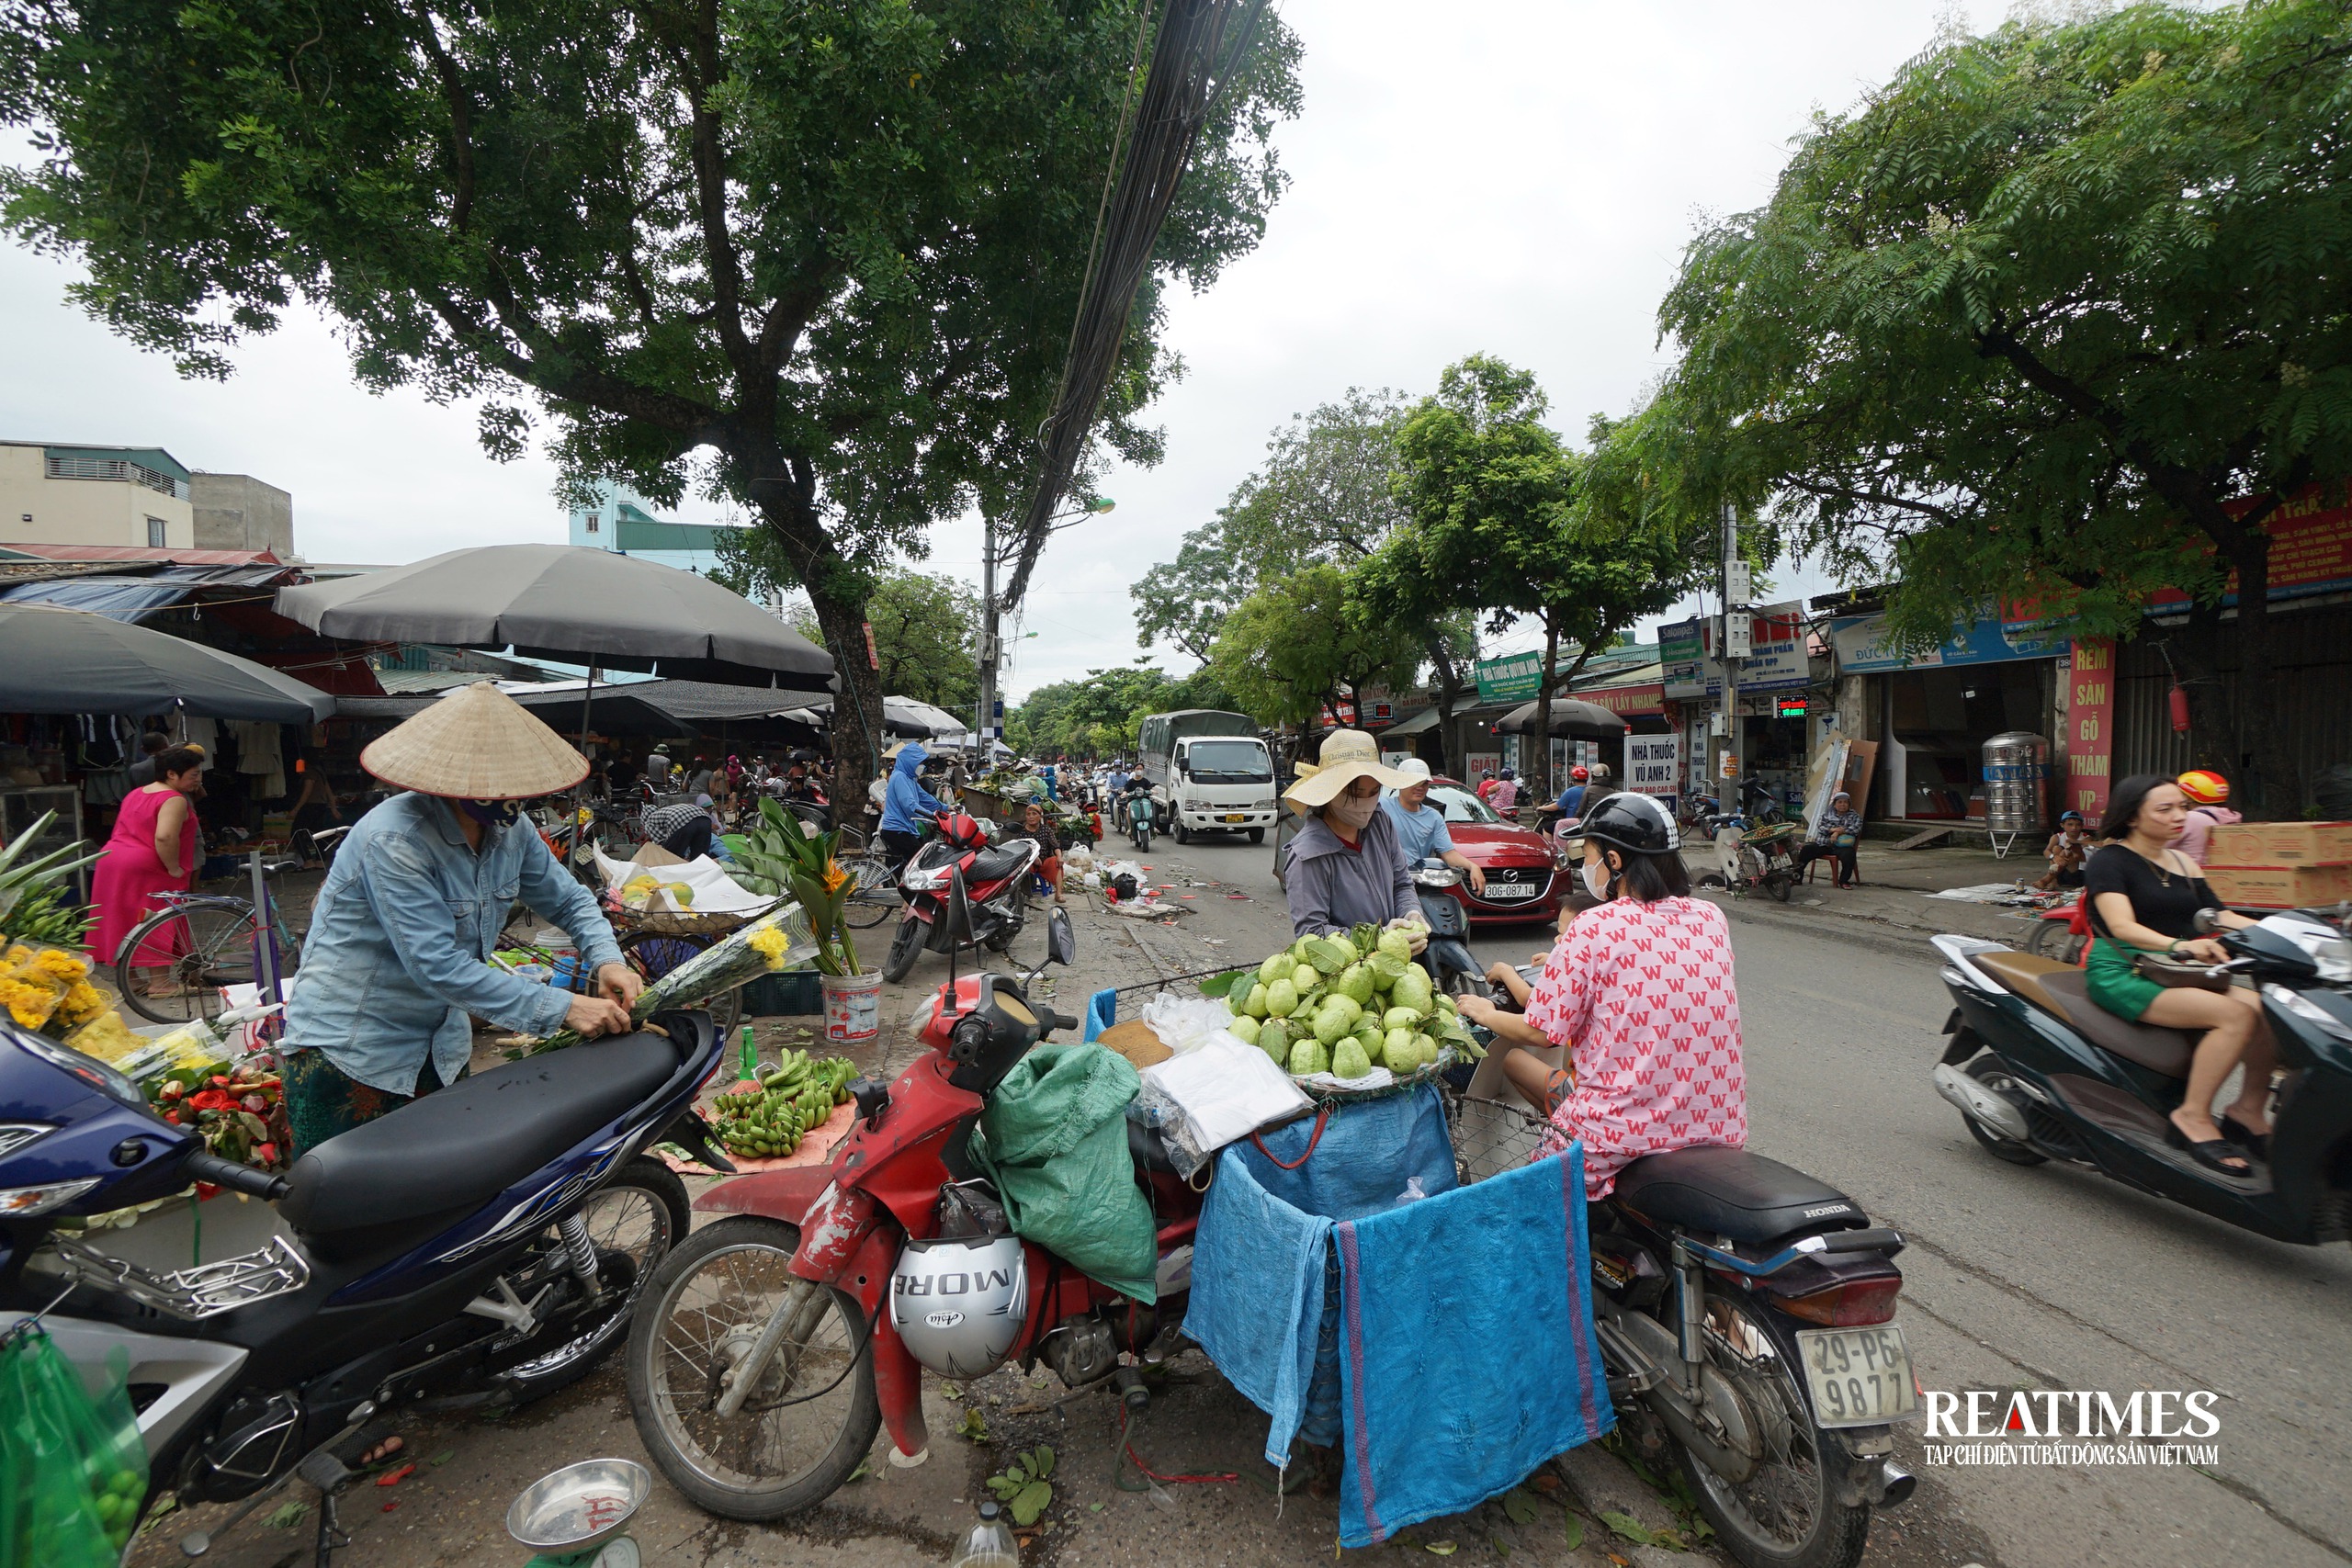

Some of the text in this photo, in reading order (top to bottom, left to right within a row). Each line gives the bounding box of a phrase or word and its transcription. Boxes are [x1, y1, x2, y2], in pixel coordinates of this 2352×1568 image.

[1662, 625, 1694, 638] Salonpas
[1615, 691, 1630, 711] LẤY
[1631, 693, 1662, 710] NHANH
[2076, 680, 2106, 706] SÀN
[2080, 711, 2099, 741] GỖ
[1631, 738, 1675, 761] NHÀ THUỐC
[2070, 746, 2109, 776] THẢM
[1635, 763, 1671, 783] VŨ ANH 2
[2078, 790, 2096, 811] VP
[1486, 885, 1533, 897] 30G-087.14
[1621, 913, 1642, 926] W
[1661, 912, 1680, 925] W
[1581, 923, 1600, 940] W
[1606, 928, 1626, 943] W
[1647, 925, 1667, 938] W
[1632, 938, 1652, 953] W
[1575, 944, 1592, 964] W
[1614, 953, 1636, 970] W
[1657, 951, 1677, 964] W
[1695, 949, 1713, 963] W
[1544, 964, 1561, 981] W
[1640, 964, 1662, 980] W
[1681, 964, 1701, 977] W
[1571, 978, 1588, 997] W
[1600, 972, 1618, 988] W
[1665, 978, 1685, 993] W
[1704, 976, 1722, 990] W
[1536, 988, 1554, 1007] W
[1622, 981, 1644, 998] W
[1646, 993, 1668, 1010] W
[1687, 991, 1707, 1007] W
[1559, 1004, 1575, 1021] W
[1606, 999, 1625, 1017] W
[1669, 1007, 1690, 1023] W
[1709, 1005, 1726, 1021] W
[1528, 1013, 1546, 1030] W
[1626, 1010, 1650, 1028] W
[1651, 1023, 1671, 1041] W
[1690, 1021, 1713, 1038] W
[1632, 1041, 1655, 1056] W
[1671, 1037, 1693, 1053] W
[1710, 1034, 1728, 1051] W
[1613, 1056, 1636, 1071] W
[1654, 1053, 1672, 1069] W
[1692, 1051, 1711, 1066] W
[1597, 1071, 1617, 1086] W
[1634, 1069, 1656, 1086] W
[1673, 1066, 1695, 1083] W
[1711, 1065, 1728, 1080] W
[1653, 1082, 1673, 1098] W
[1693, 1080, 1712, 1095] W
[1671, 1096, 1692, 1111] W
[1709, 1093, 1727, 1109] W
[1649, 1109, 1670, 1122] W
[1690, 1108, 1709, 1123] W
[1602, 1125, 1626, 1145] W
[1624, 1119, 1648, 1137] W
[1669, 1123, 1689, 1137] W
[1707, 1121, 1725, 1136] W
[1803, 1203, 1851, 1219] HONDA
[894, 1268, 1010, 1296] MORE
[930, 1313, 960, 1325] Asia
[1814, 1332, 1898, 1375] 29-P6
[1826, 1373, 1902, 1416] 9877
